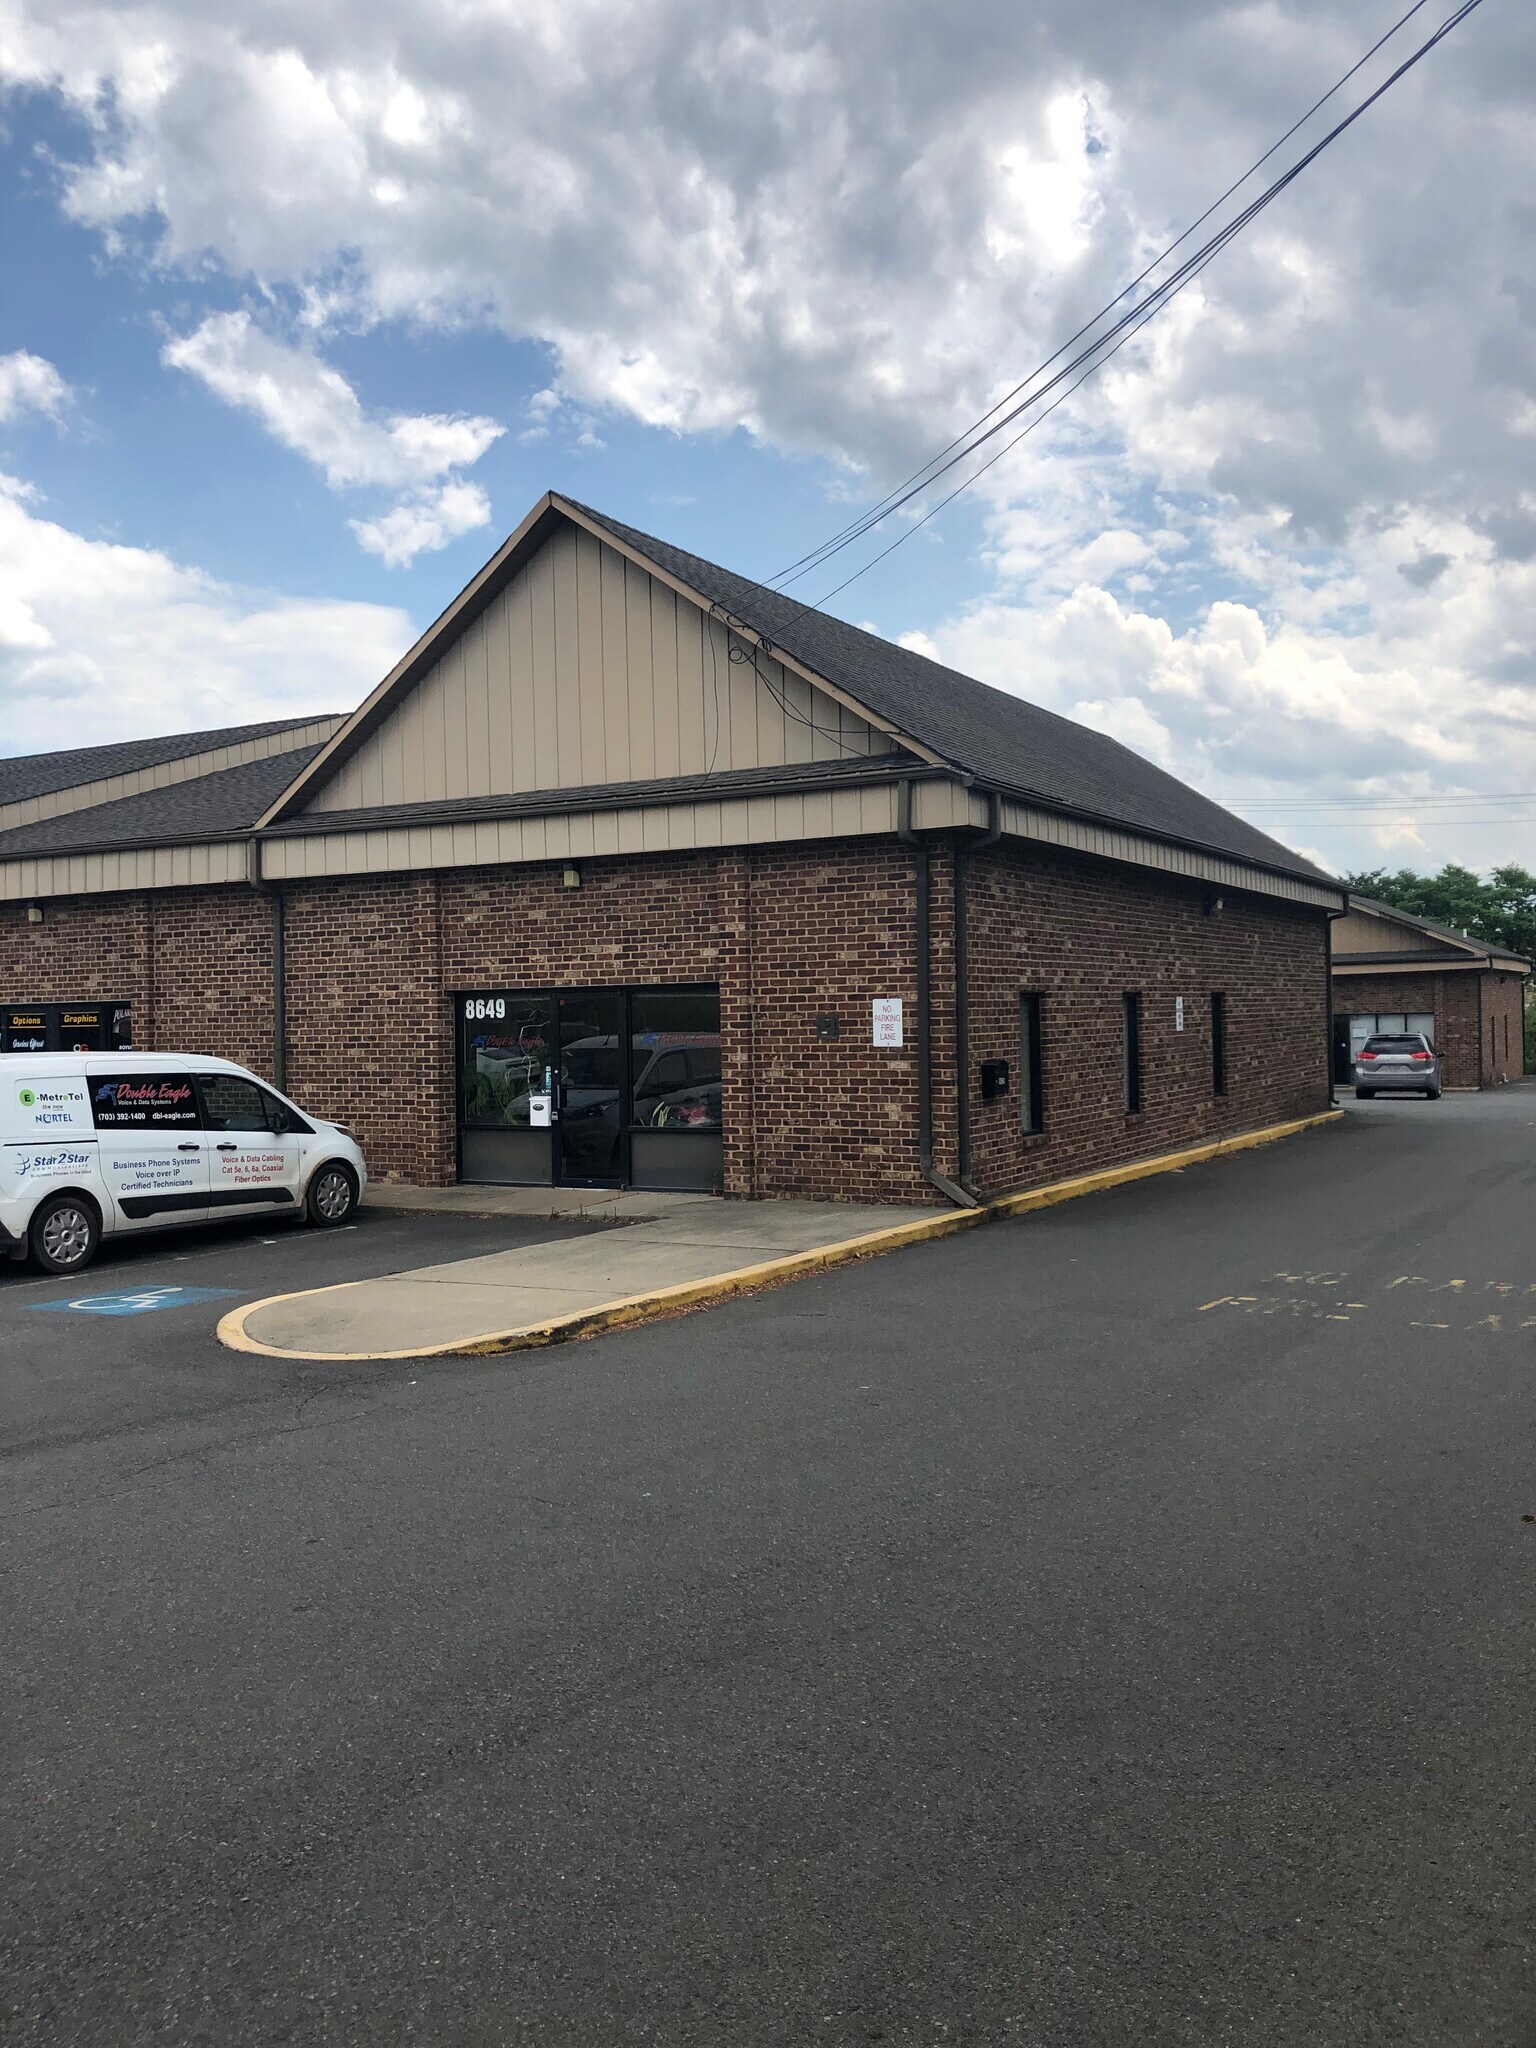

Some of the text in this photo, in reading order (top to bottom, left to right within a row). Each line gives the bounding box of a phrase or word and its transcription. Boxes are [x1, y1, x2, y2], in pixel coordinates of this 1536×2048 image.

[466, 998, 506, 1019] 8649
[13, 1016, 41, 1026] Options
[64, 1014, 98, 1024] Graphics
[116, 1083, 192, 1104] Double Eagle
[36, 1114, 72, 1124] NORTEL
[152, 1112, 196, 1120] dbl-eagle.com
[34, 1153, 90, 1166] Star2Star
[262, 1154, 284, 1163] Cabling
[113, 1158, 200, 1170] Business Phone Systems
[136, 1171, 154, 1179] Voice
[252, 1175, 272, 1183] Optics
[120, 1179, 193, 1191] Certified Technicians
